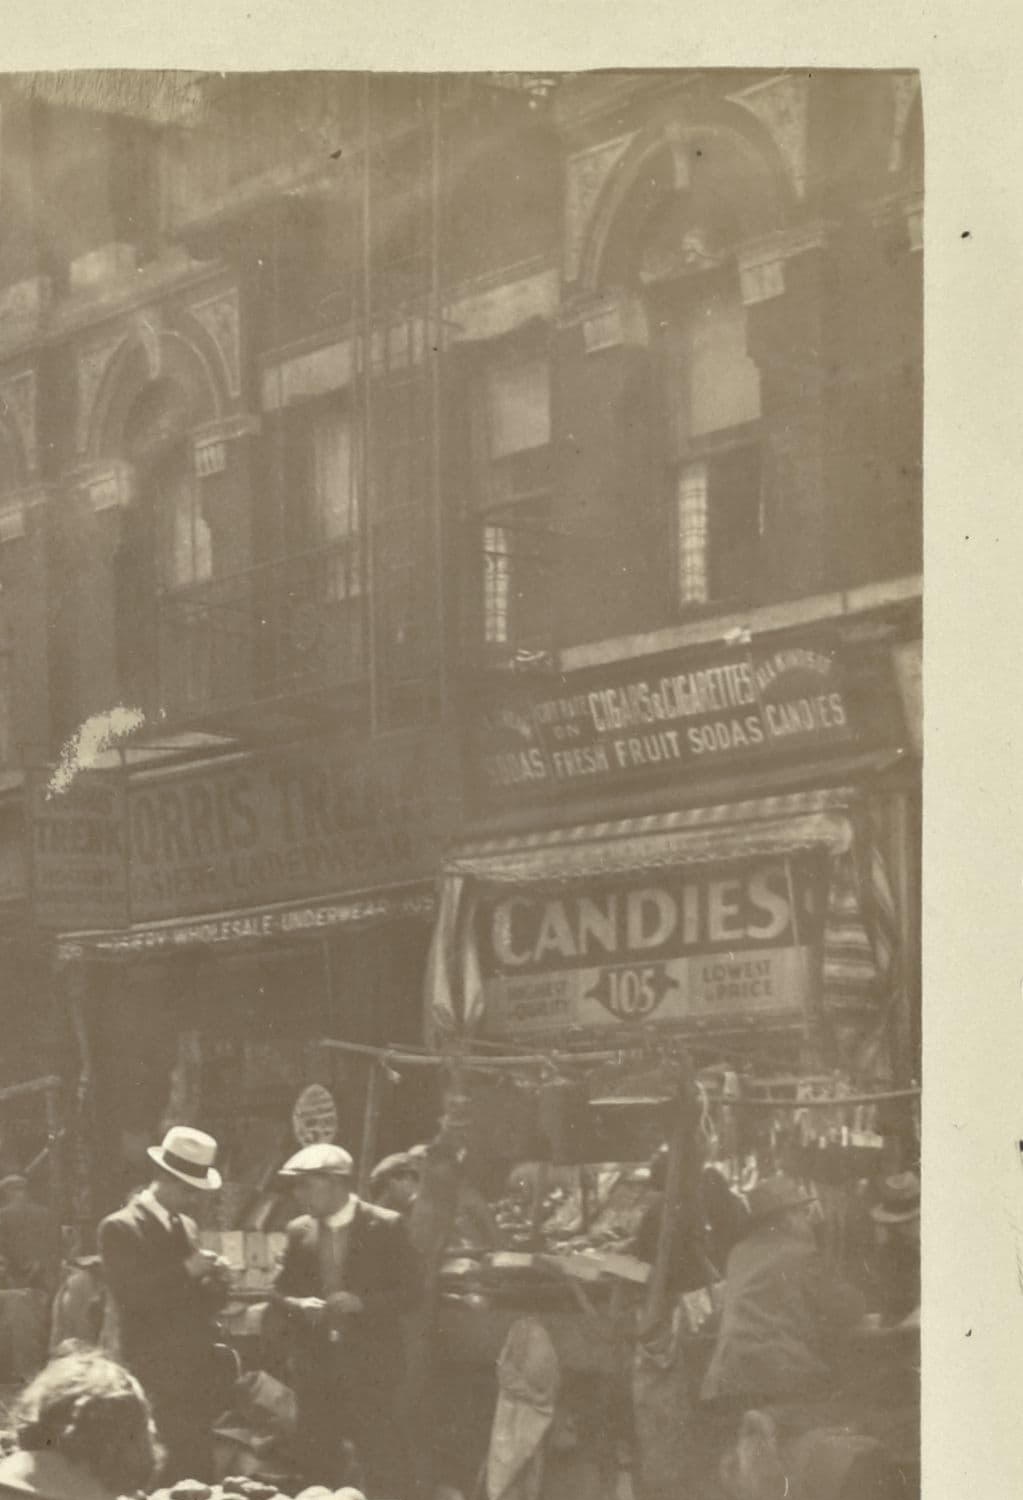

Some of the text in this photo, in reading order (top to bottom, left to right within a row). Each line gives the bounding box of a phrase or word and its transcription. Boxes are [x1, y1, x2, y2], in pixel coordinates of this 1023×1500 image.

[661, 662, 757, 720] CIGARETTES
[551, 744, 609, 779] FRESH
[614, 731, 682, 768] FRUIT
[687, 715, 765, 755] SODAS
[765, 693, 846, 737] CANDIES
[131, 774, 260, 864] ORRIS
[492, 874, 790, 967] CANDIES
[607, 969, 655, 1013] 105
[702, 959, 772, 983] LOWEST
[715, 979, 773, 1001] PRICE
